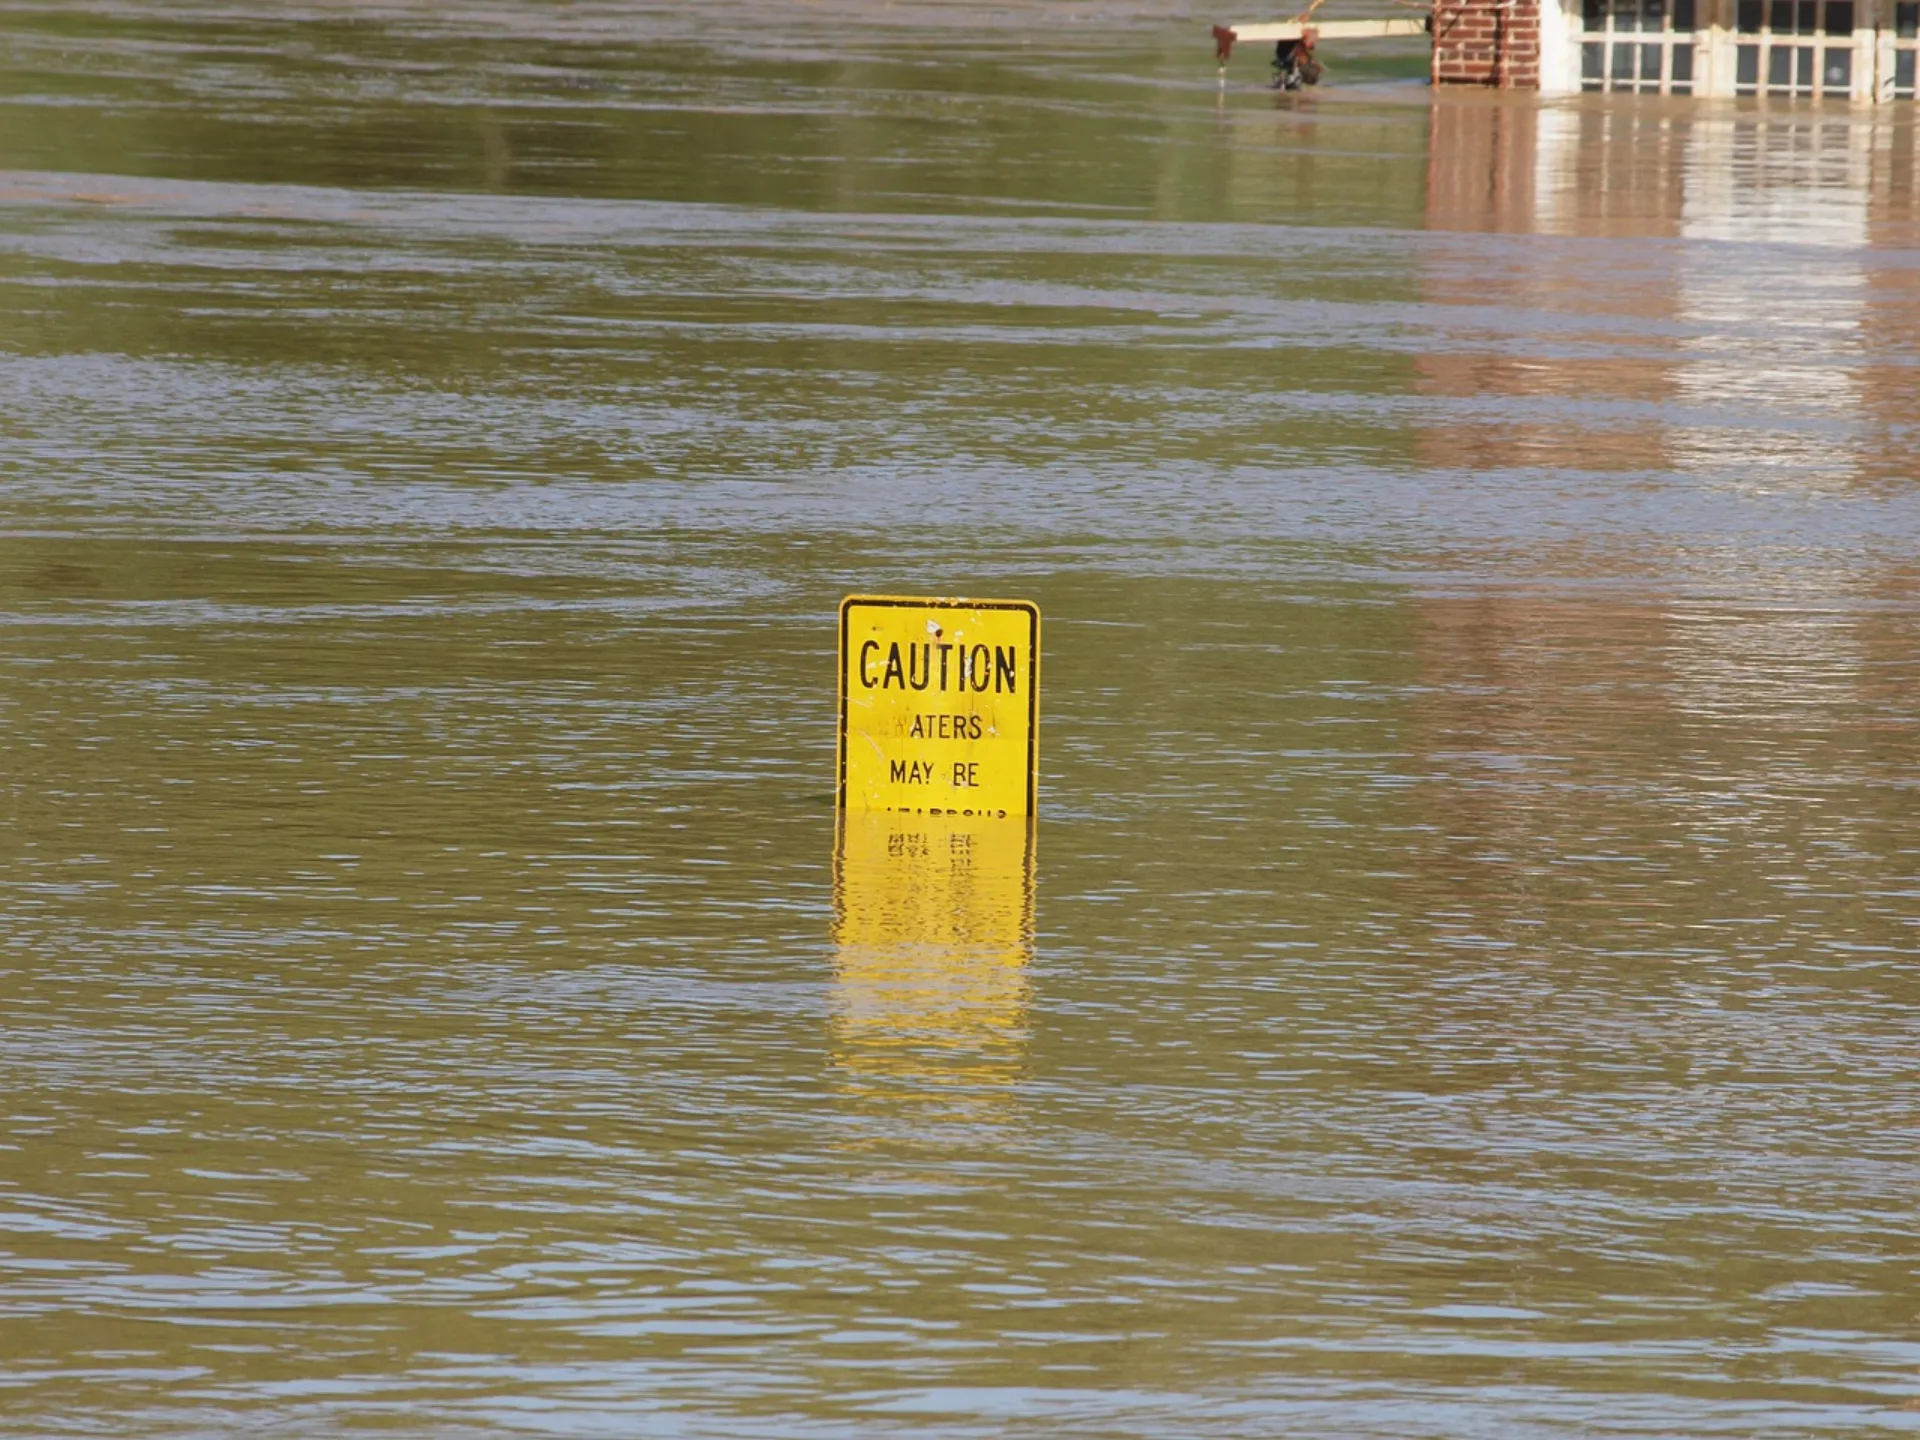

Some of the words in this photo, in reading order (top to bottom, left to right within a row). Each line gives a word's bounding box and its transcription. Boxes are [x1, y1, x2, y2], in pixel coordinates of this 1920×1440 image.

[860, 639, 1016, 693] CAUTION
[896, 714, 983, 740] ATERS
[890, 760, 934, 785] MAY
[953, 763, 980, 787] BE
